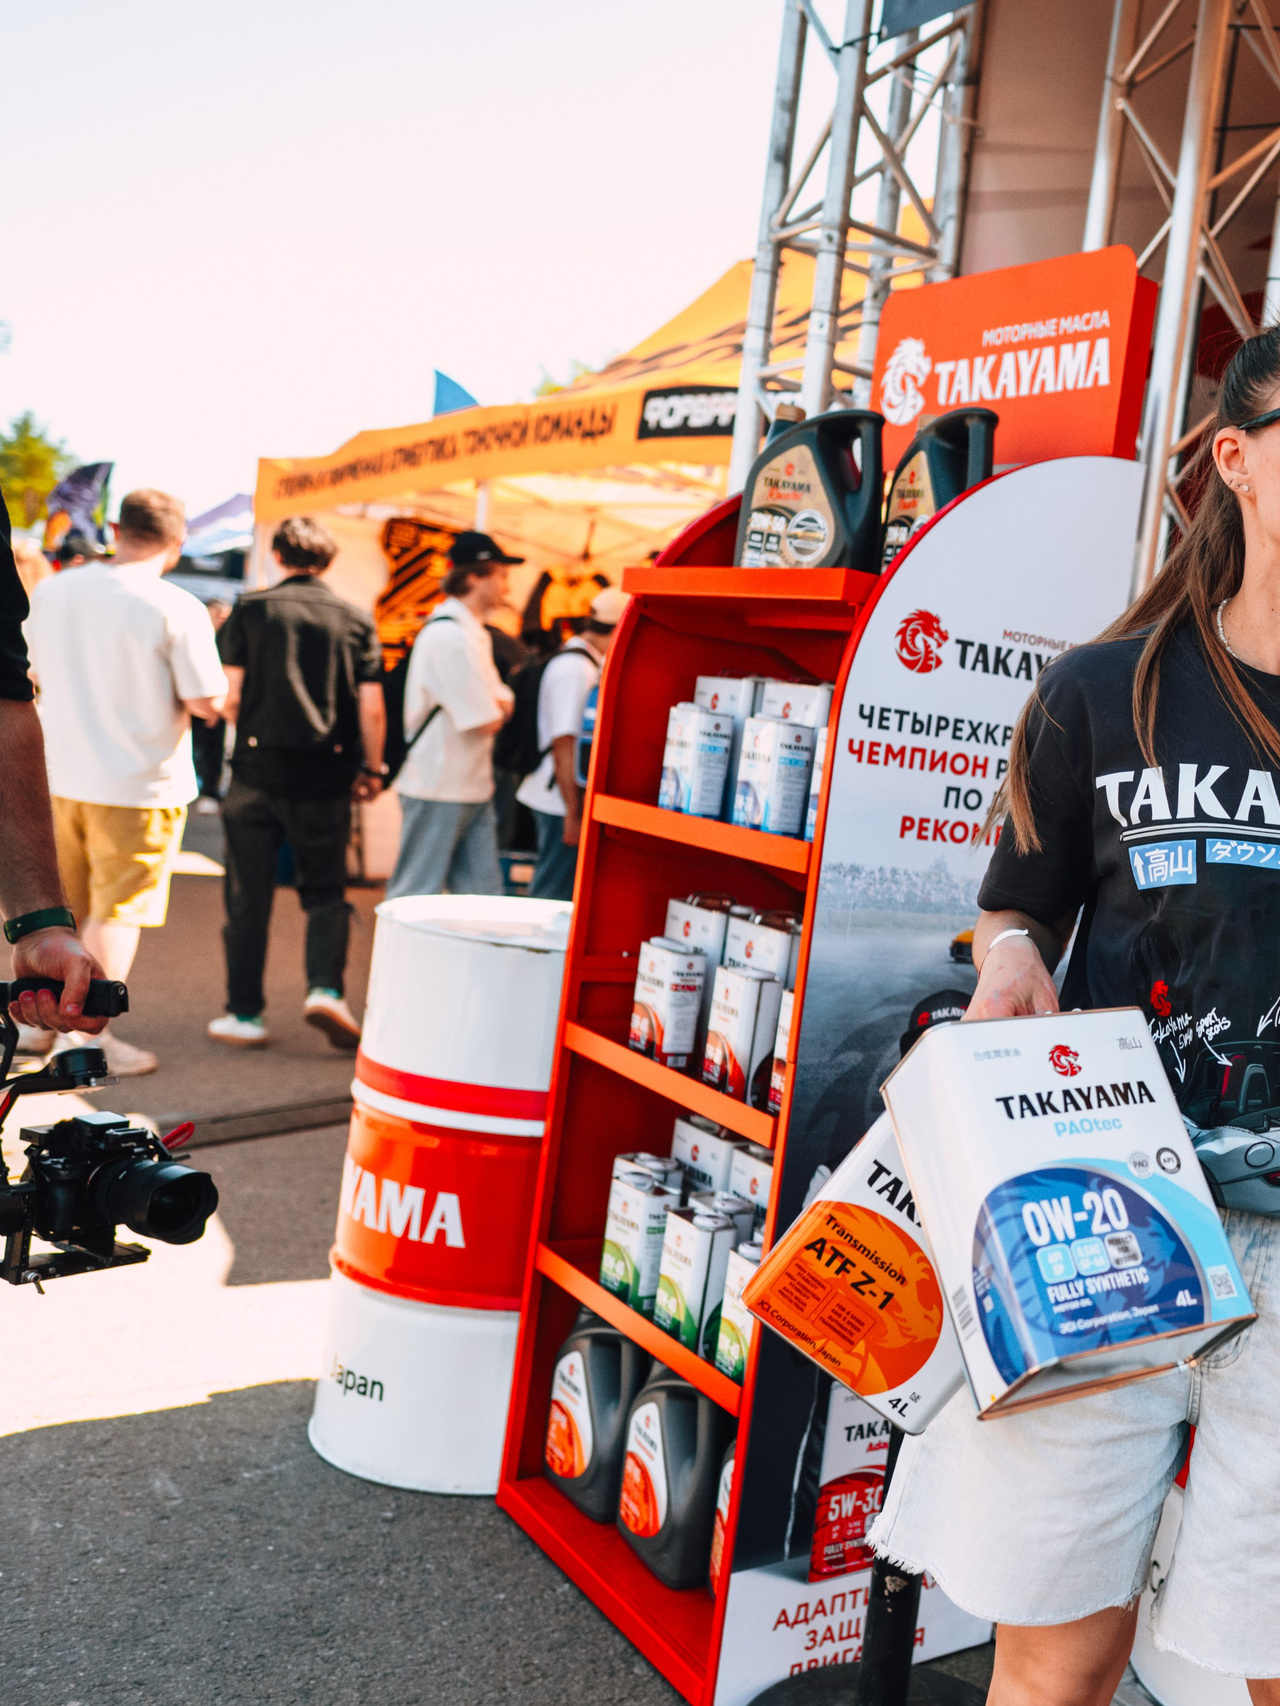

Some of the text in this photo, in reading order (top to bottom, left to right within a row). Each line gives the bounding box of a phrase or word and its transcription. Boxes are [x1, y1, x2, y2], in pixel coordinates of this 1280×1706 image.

[982, 310, 1110, 348] МОТОРНЫЕ МАСЛА
[934, 337, 1110, 407] TAKAYAMA
[764, 477, 811, 493] TAKAYAMA
[1003, 629, 1066, 651] МОТОРНЫЕ
[848, 738, 989, 779] ЧЕМПИОН
[944, 786, 983, 811] ПО
[1148, 845, 1193, 882] 高山
[1117, 1036, 1143, 1051] 高山
[995, 1080, 1156, 1120] TAKAYAMA
[1053, 1117, 1123, 1137] PAOtec
[867, 1159, 922, 1228] TAK
[1022, 1188, 1129, 1246] 0W-20
[825, 1213, 907, 1286] Transmission
[804, 1236, 895, 1311] ATF Z-1
[1046, 1266, 1149, 1305] FULLY SYNTHETIC
[1176, 1289, 1197, 1307] 4L
[758, 1298, 842, 1366] JCI Corporation, Japan
[888, 1396, 907, 1417] 4L
